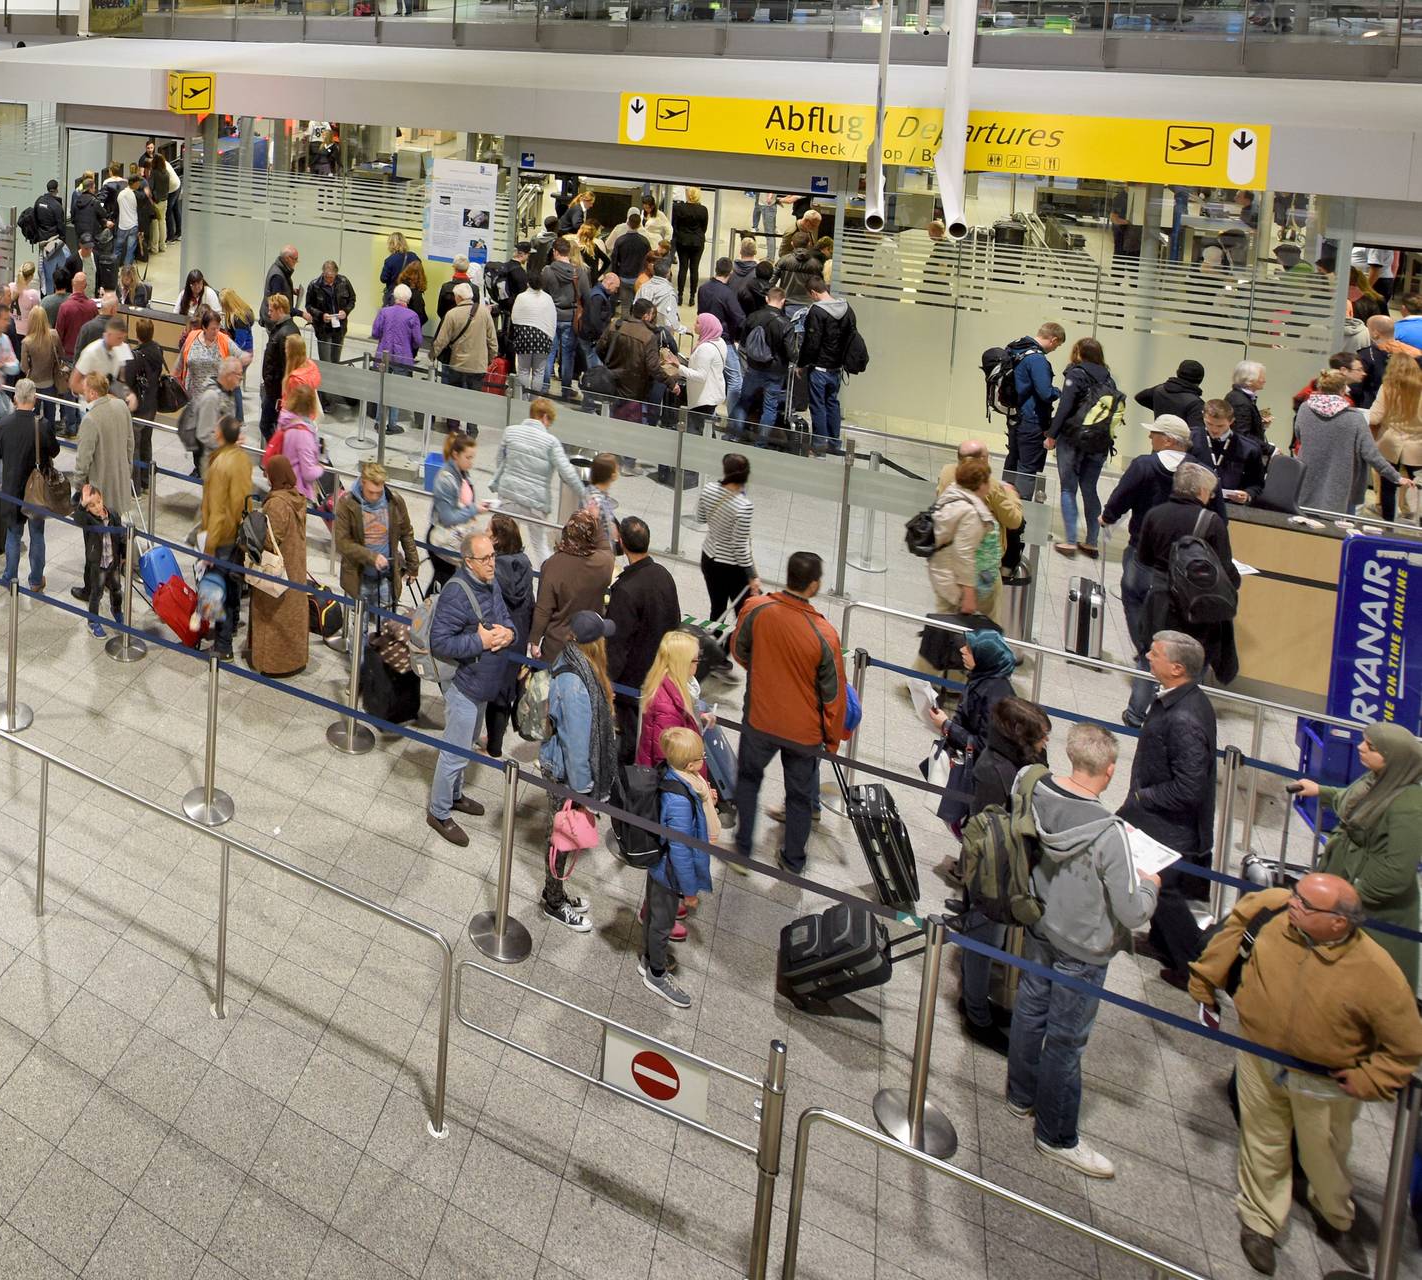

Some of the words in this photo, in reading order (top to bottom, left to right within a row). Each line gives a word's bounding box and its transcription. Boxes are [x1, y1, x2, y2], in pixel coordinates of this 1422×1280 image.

[765, 105, 866, 141] Abflug
[765, 138, 795, 152] Visa
[801, 140, 846, 156] Check
[1392, 568, 1408, 630] AIRLINE
[1350, 559, 1392, 724] RYANAIR
[1386, 632, 1402, 700] ON-TIME
